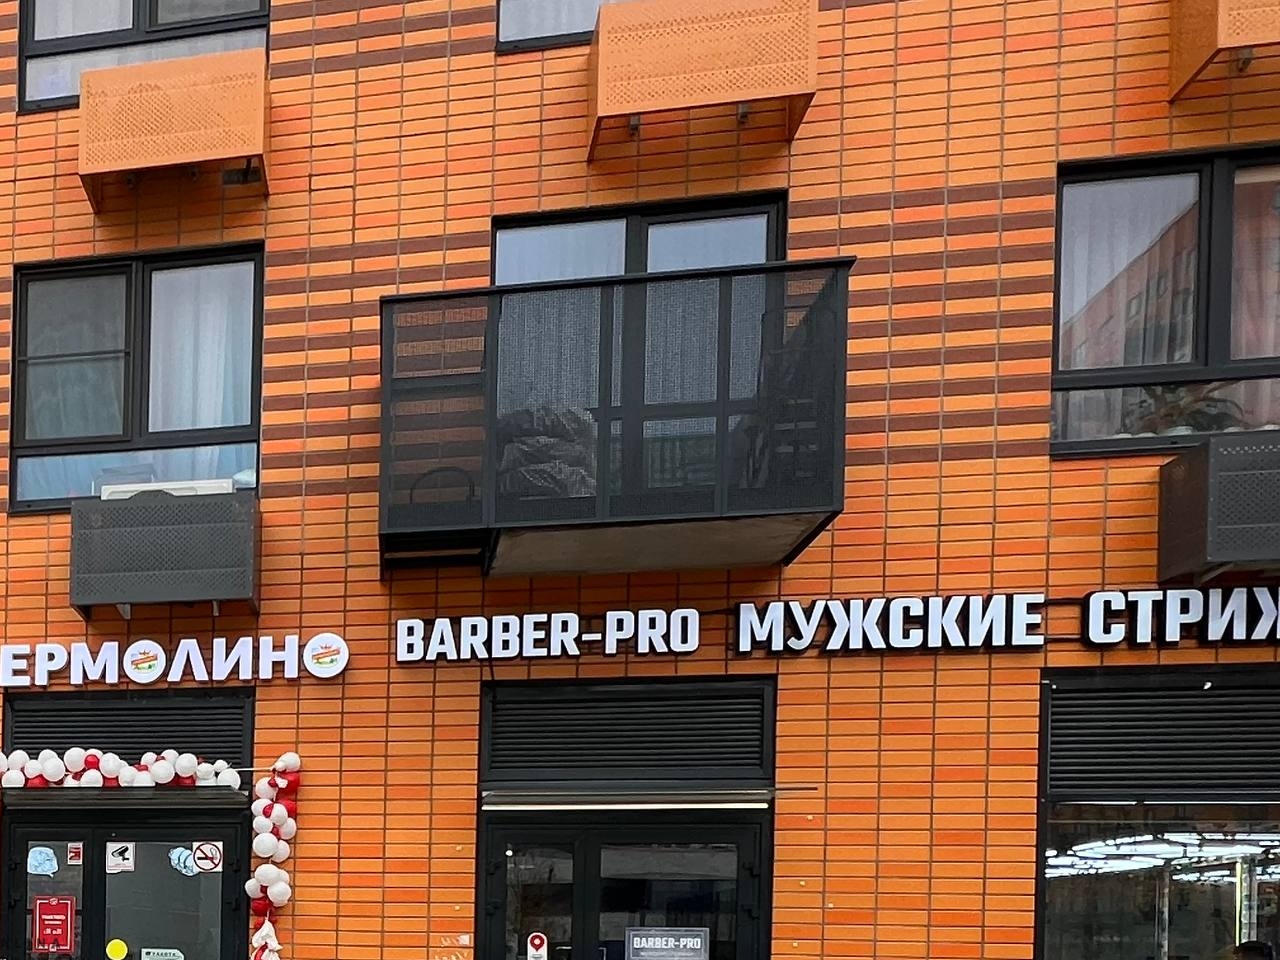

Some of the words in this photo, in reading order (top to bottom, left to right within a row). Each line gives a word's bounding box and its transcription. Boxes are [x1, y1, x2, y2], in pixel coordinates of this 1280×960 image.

[396, 608, 700, 662] BARBER-PRO
[738, 592, 1046, 652] МУЖСКИЕ
[633, 937, 701, 949] BARBER-PRO
